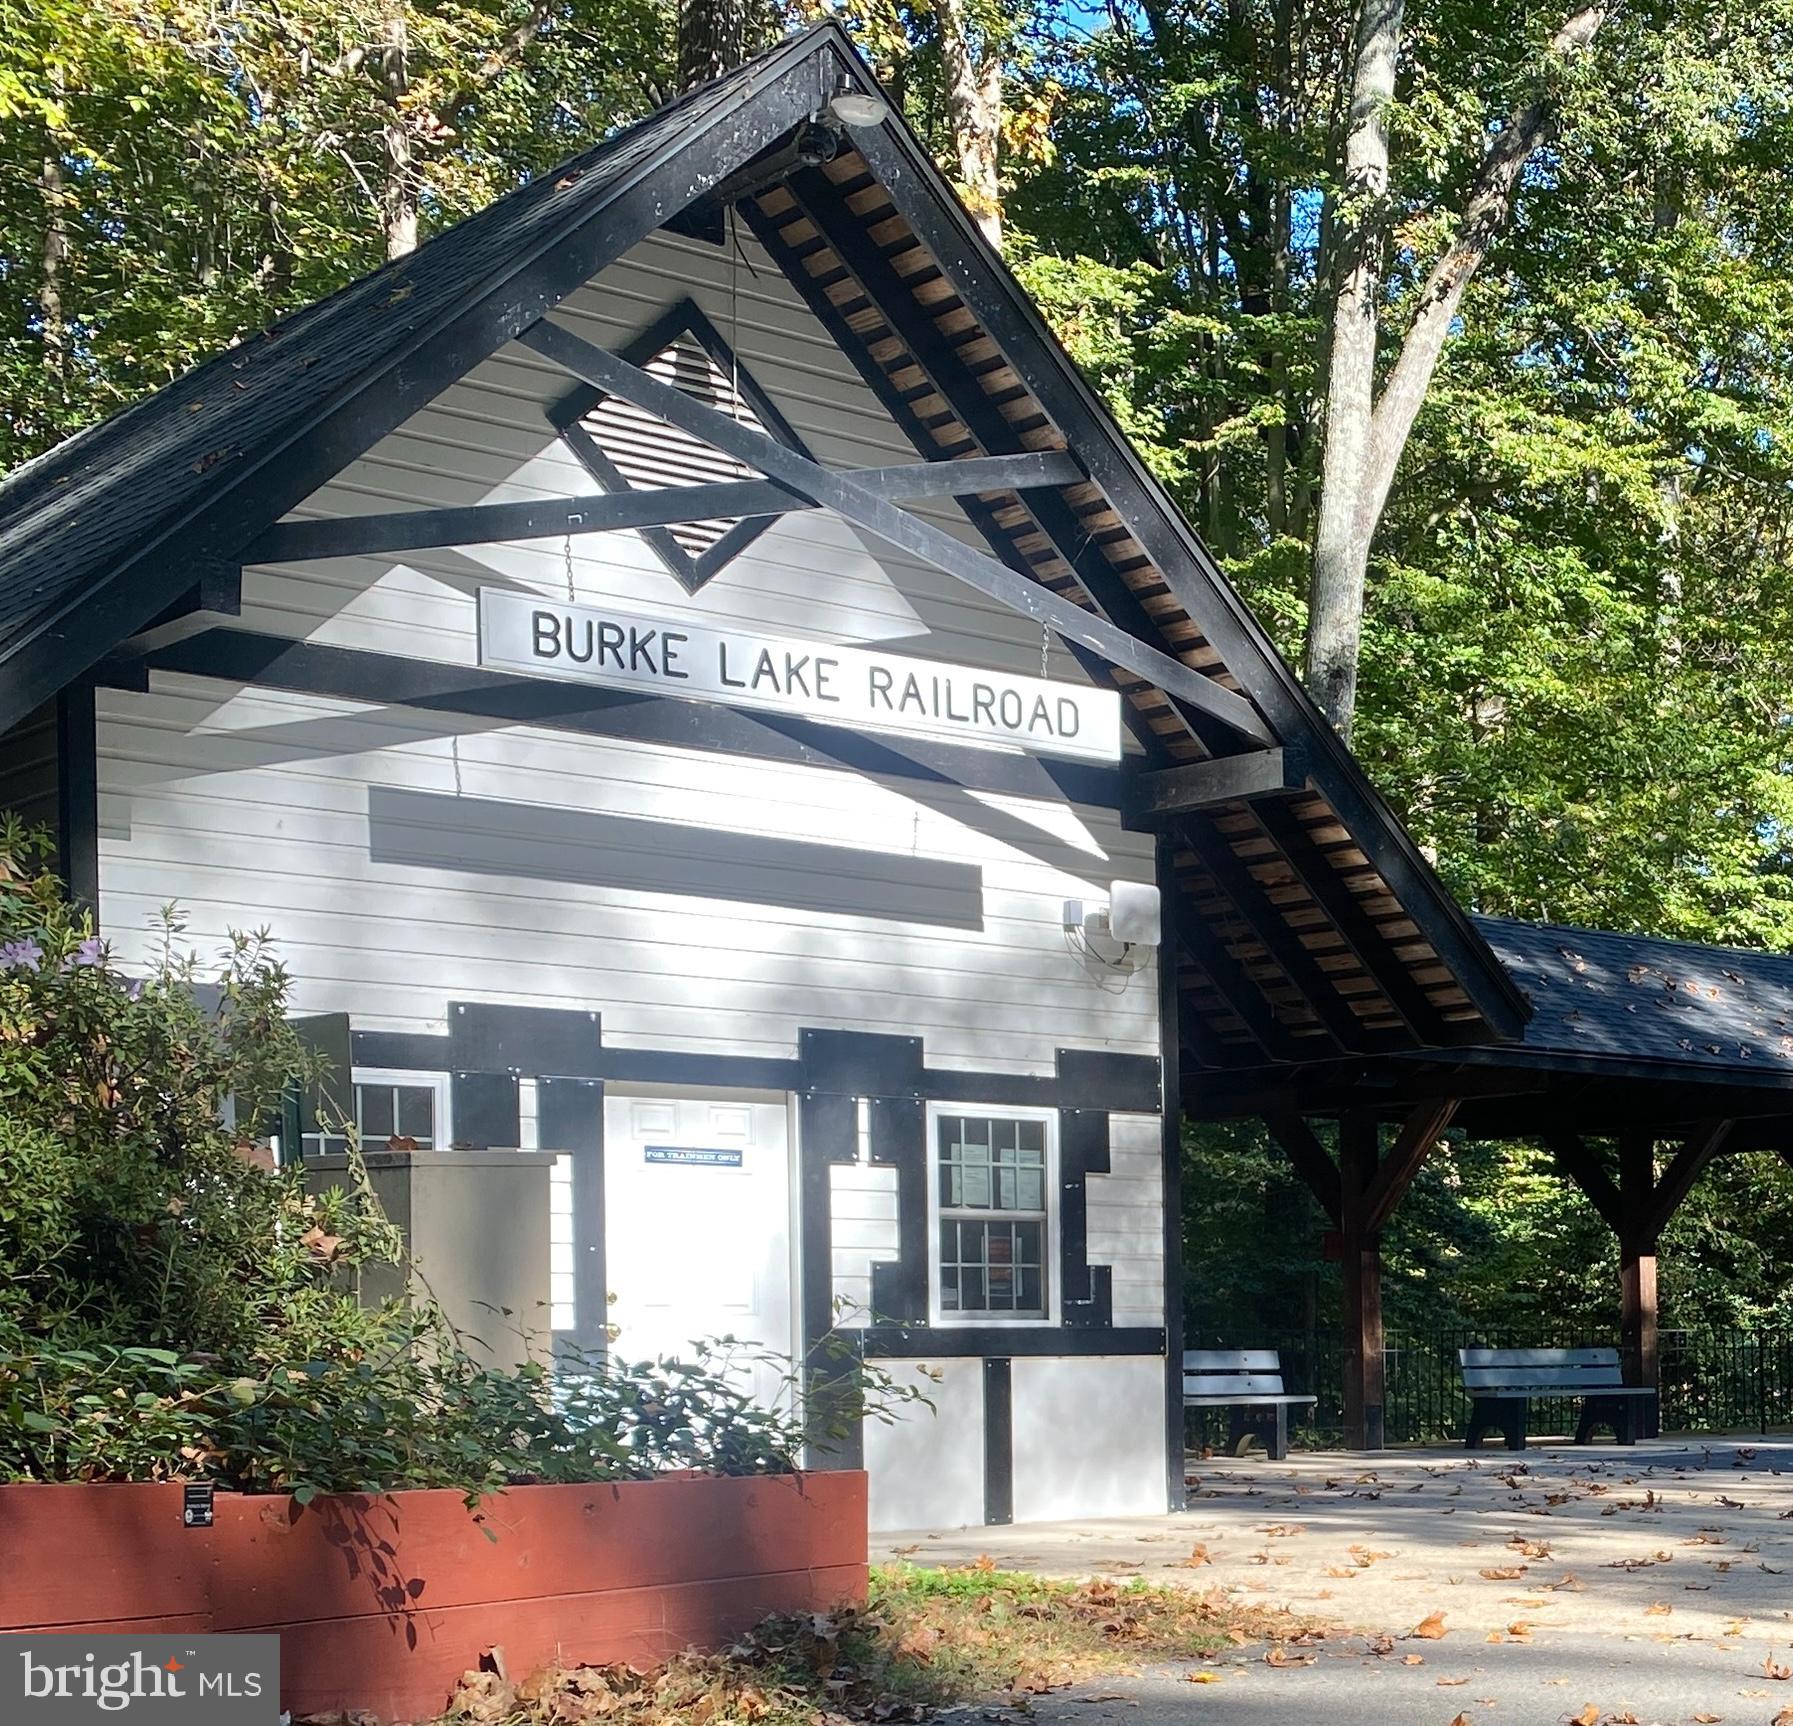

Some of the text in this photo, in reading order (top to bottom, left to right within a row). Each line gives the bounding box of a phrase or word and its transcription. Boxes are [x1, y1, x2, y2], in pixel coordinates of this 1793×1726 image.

[532, 610, 1081, 739] BURKE LAKE RAILROAD
[667, 1152, 717, 1160] TRAINMEN
[717, 1154, 741, 1162] ONLY
